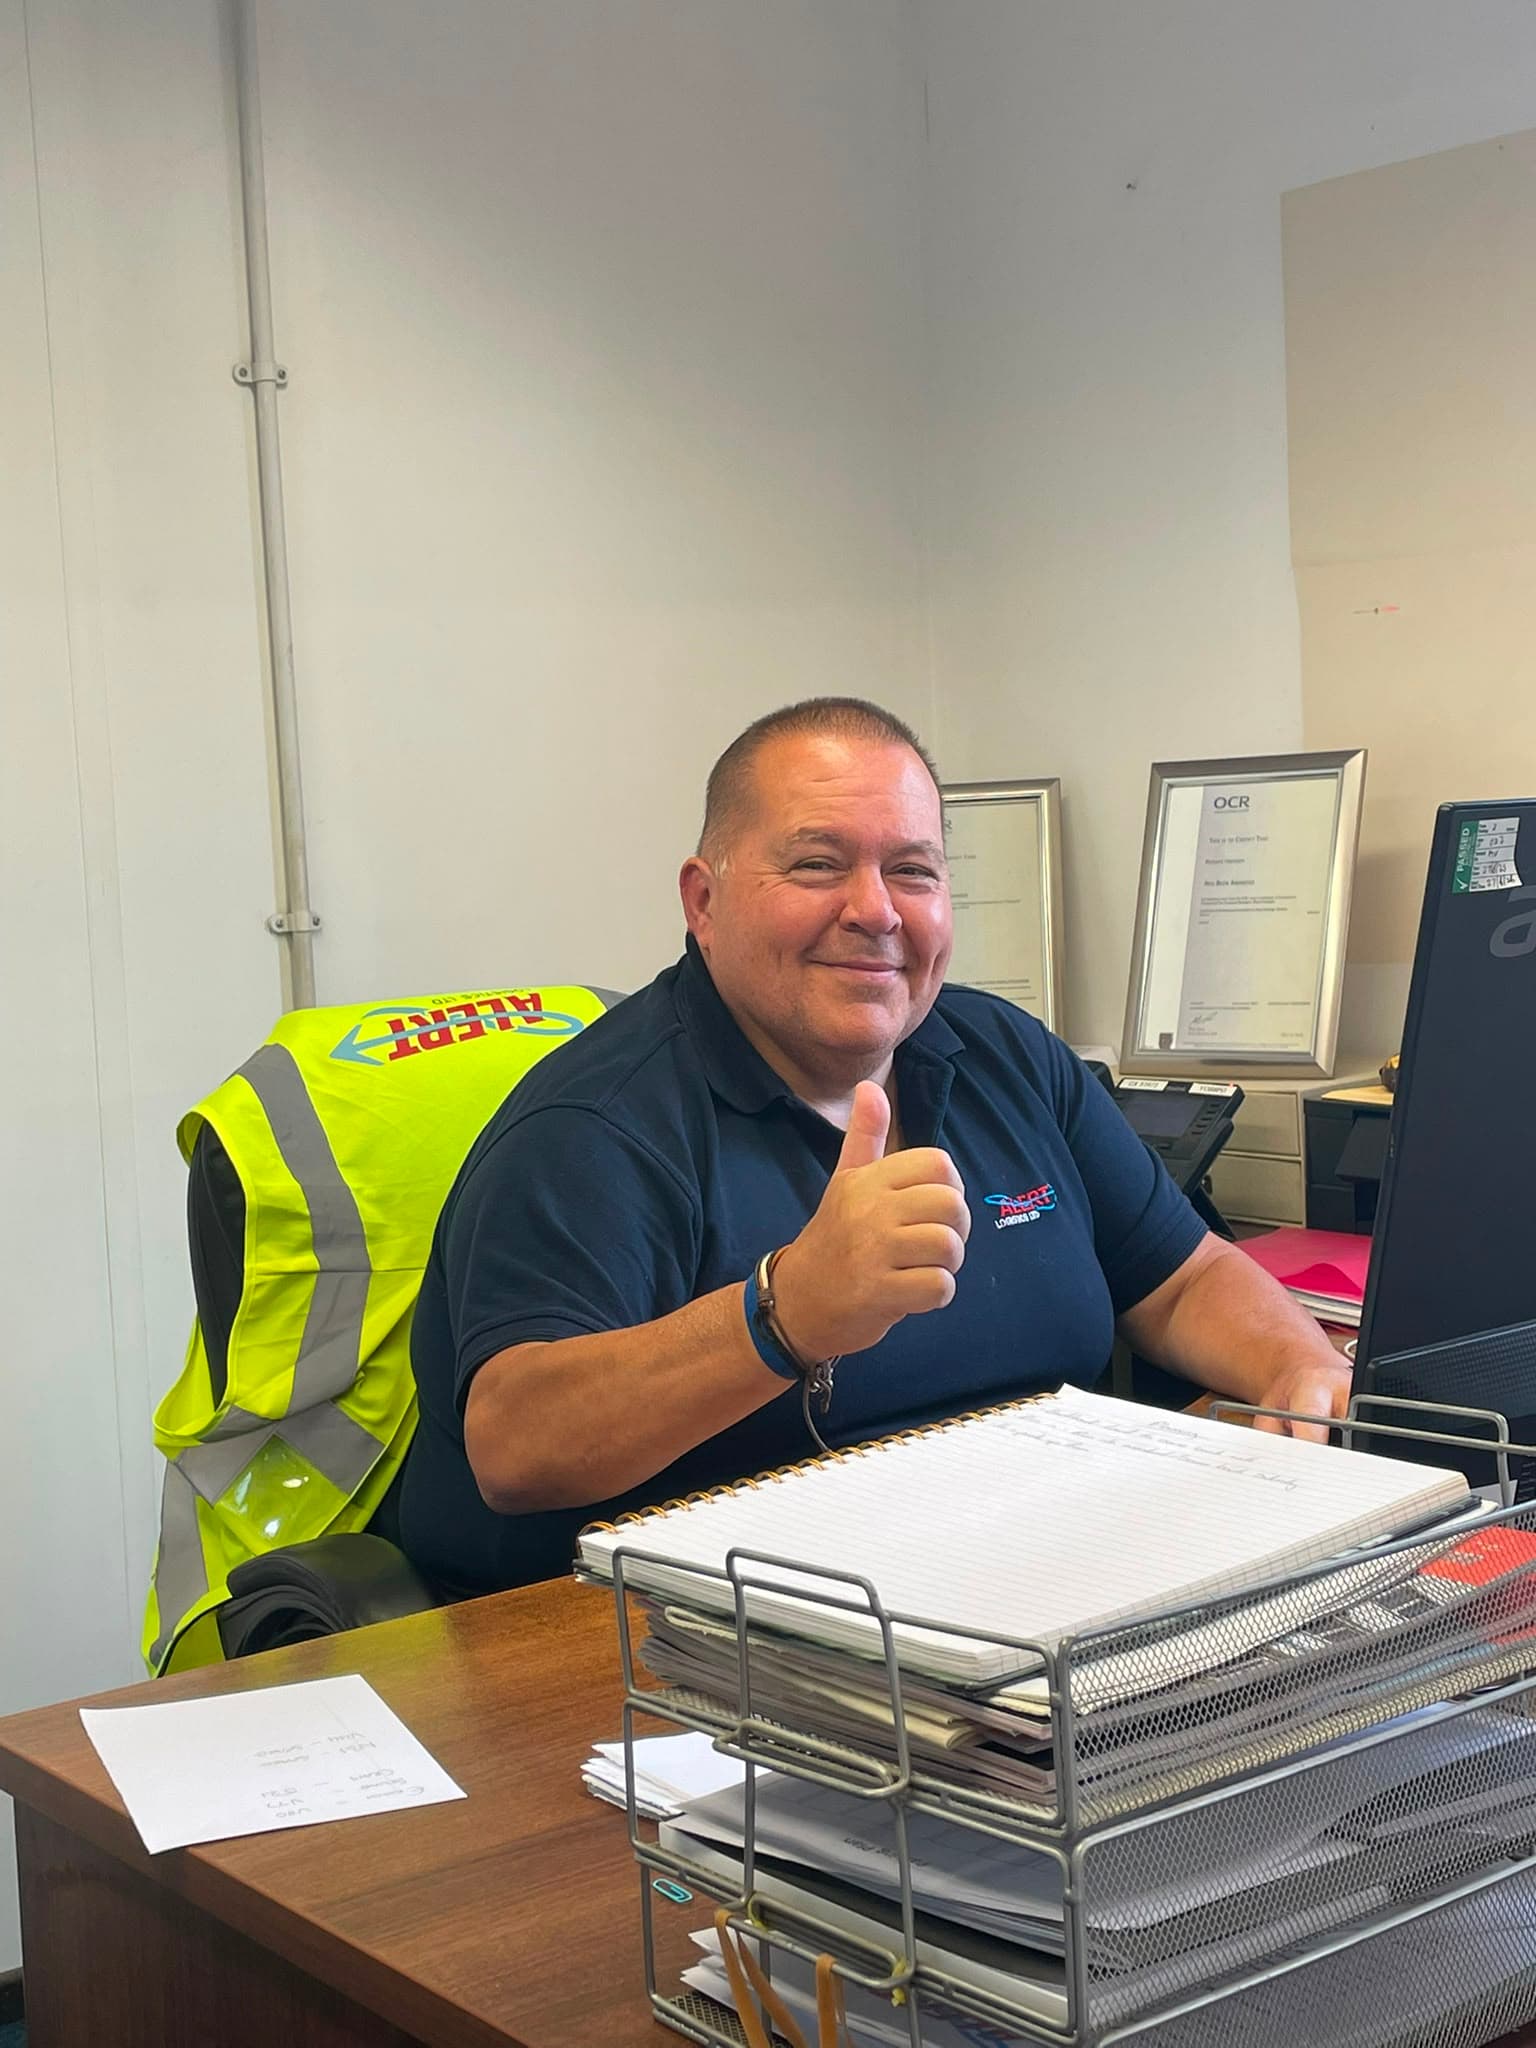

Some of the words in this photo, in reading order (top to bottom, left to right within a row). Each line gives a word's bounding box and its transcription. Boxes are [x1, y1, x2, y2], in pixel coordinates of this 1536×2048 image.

[1213, 795, 1250, 810] OCR
[1456, 827, 1471, 873] PASSED
[386, 992, 545, 1061] ALERT
[999, 1183, 1051, 1218] ALERT
